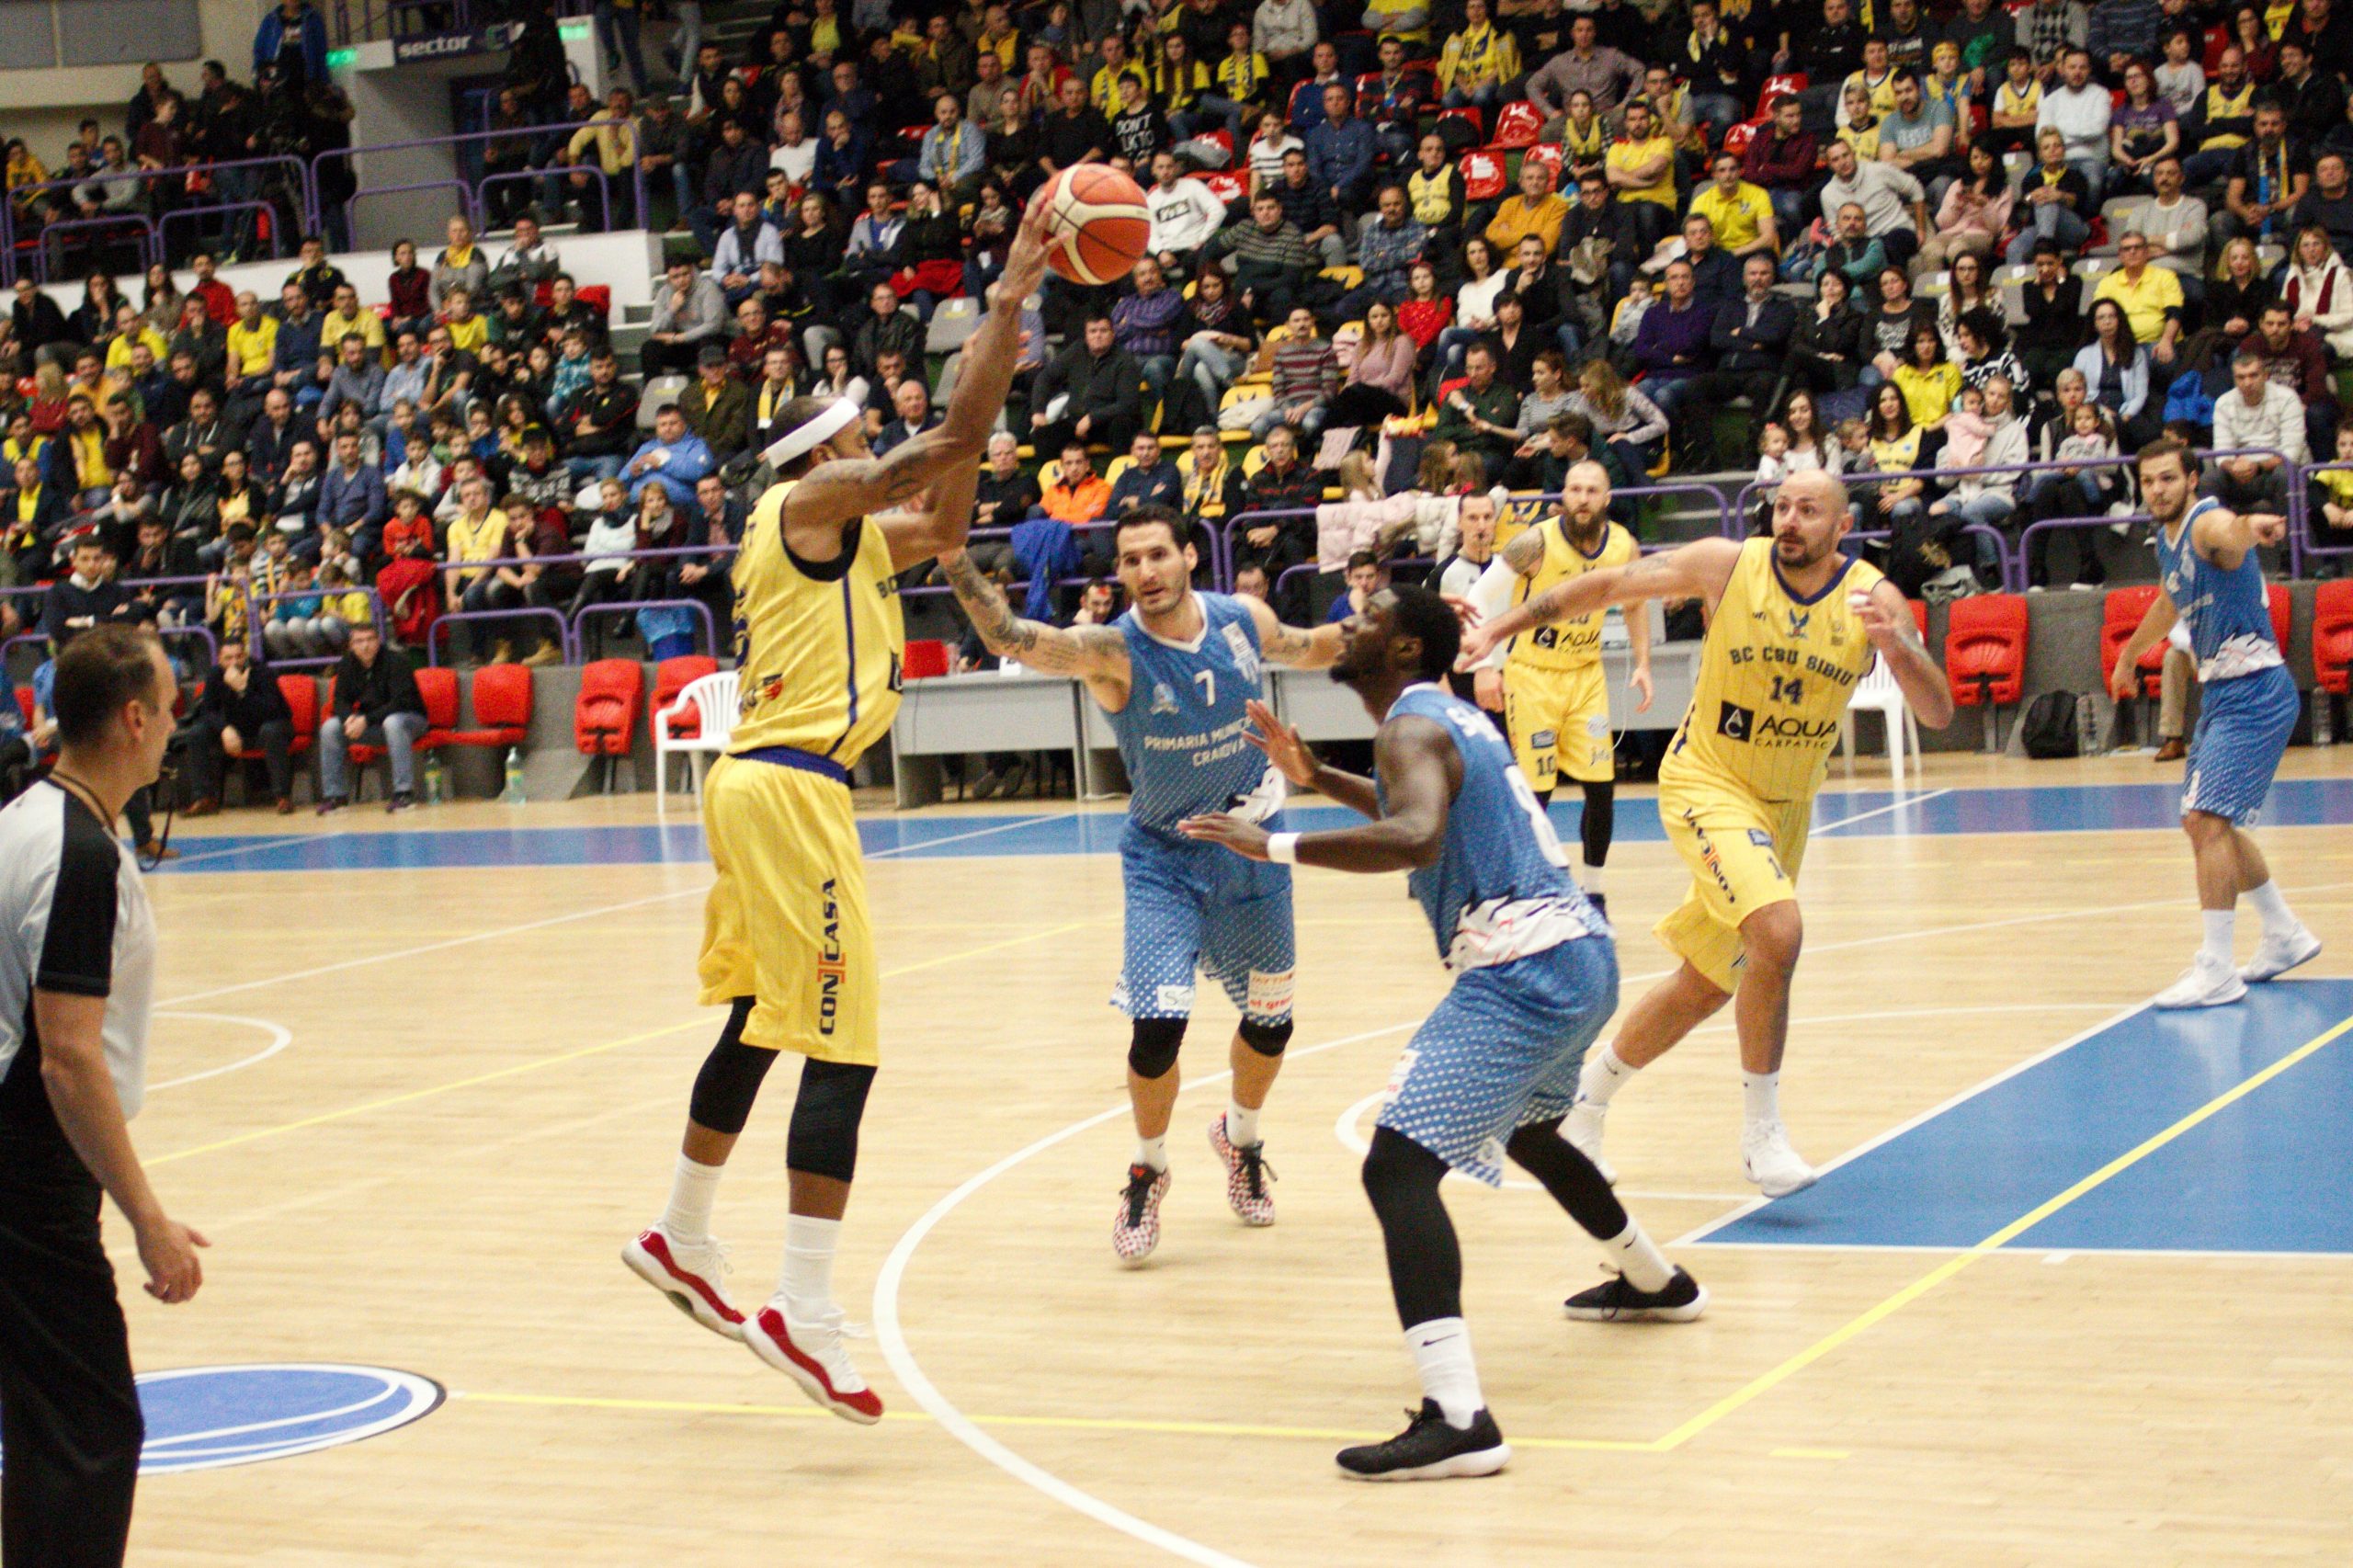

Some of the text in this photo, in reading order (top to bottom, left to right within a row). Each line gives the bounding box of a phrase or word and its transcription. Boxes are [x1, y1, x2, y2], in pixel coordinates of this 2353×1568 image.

[399, 35, 472, 57] sector
[1729, 646, 1854, 687] BC CSU SIBIU
[1194, 668, 1216, 707] 7
[1768, 675, 1805, 705] 14
[1756, 714, 1836, 739] AQUA
[1143, 733, 1209, 751] PRIMARIA
[1536, 755, 1556, 776] 10
